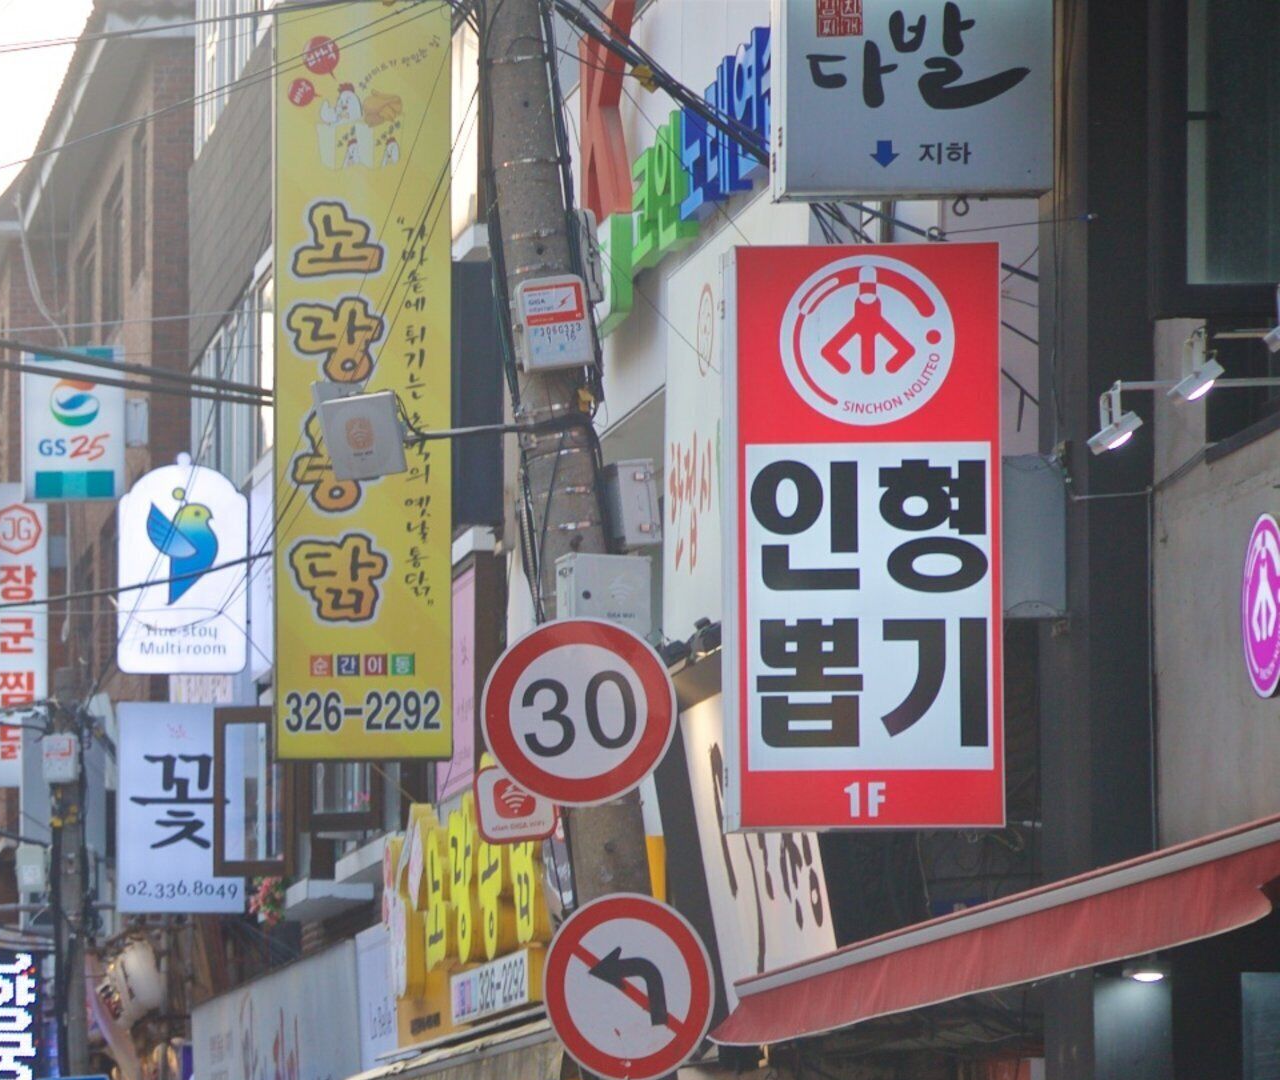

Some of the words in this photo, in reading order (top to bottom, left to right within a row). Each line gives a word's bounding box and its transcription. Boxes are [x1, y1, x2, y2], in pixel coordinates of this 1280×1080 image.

[806, 10, 1032, 109] 다발
[918, 142, 972, 165] 지하
[842, 397, 904, 415] SINCHON
[903, 351, 941, 404] NOLITEO
[39, 433, 110, 461] GS25
[2, 516, 33, 543] JG
[750, 459, 988, 593] 인형
[310, 655, 416, 676] 순간이동
[756, 617, 989, 749] 뽑기
[284, 690, 441, 734] 326-2292
[521, 669, 637, 758] 30
[131, 754, 230, 849] 꽃
[477, 956, 527, 1011] 326-2292
